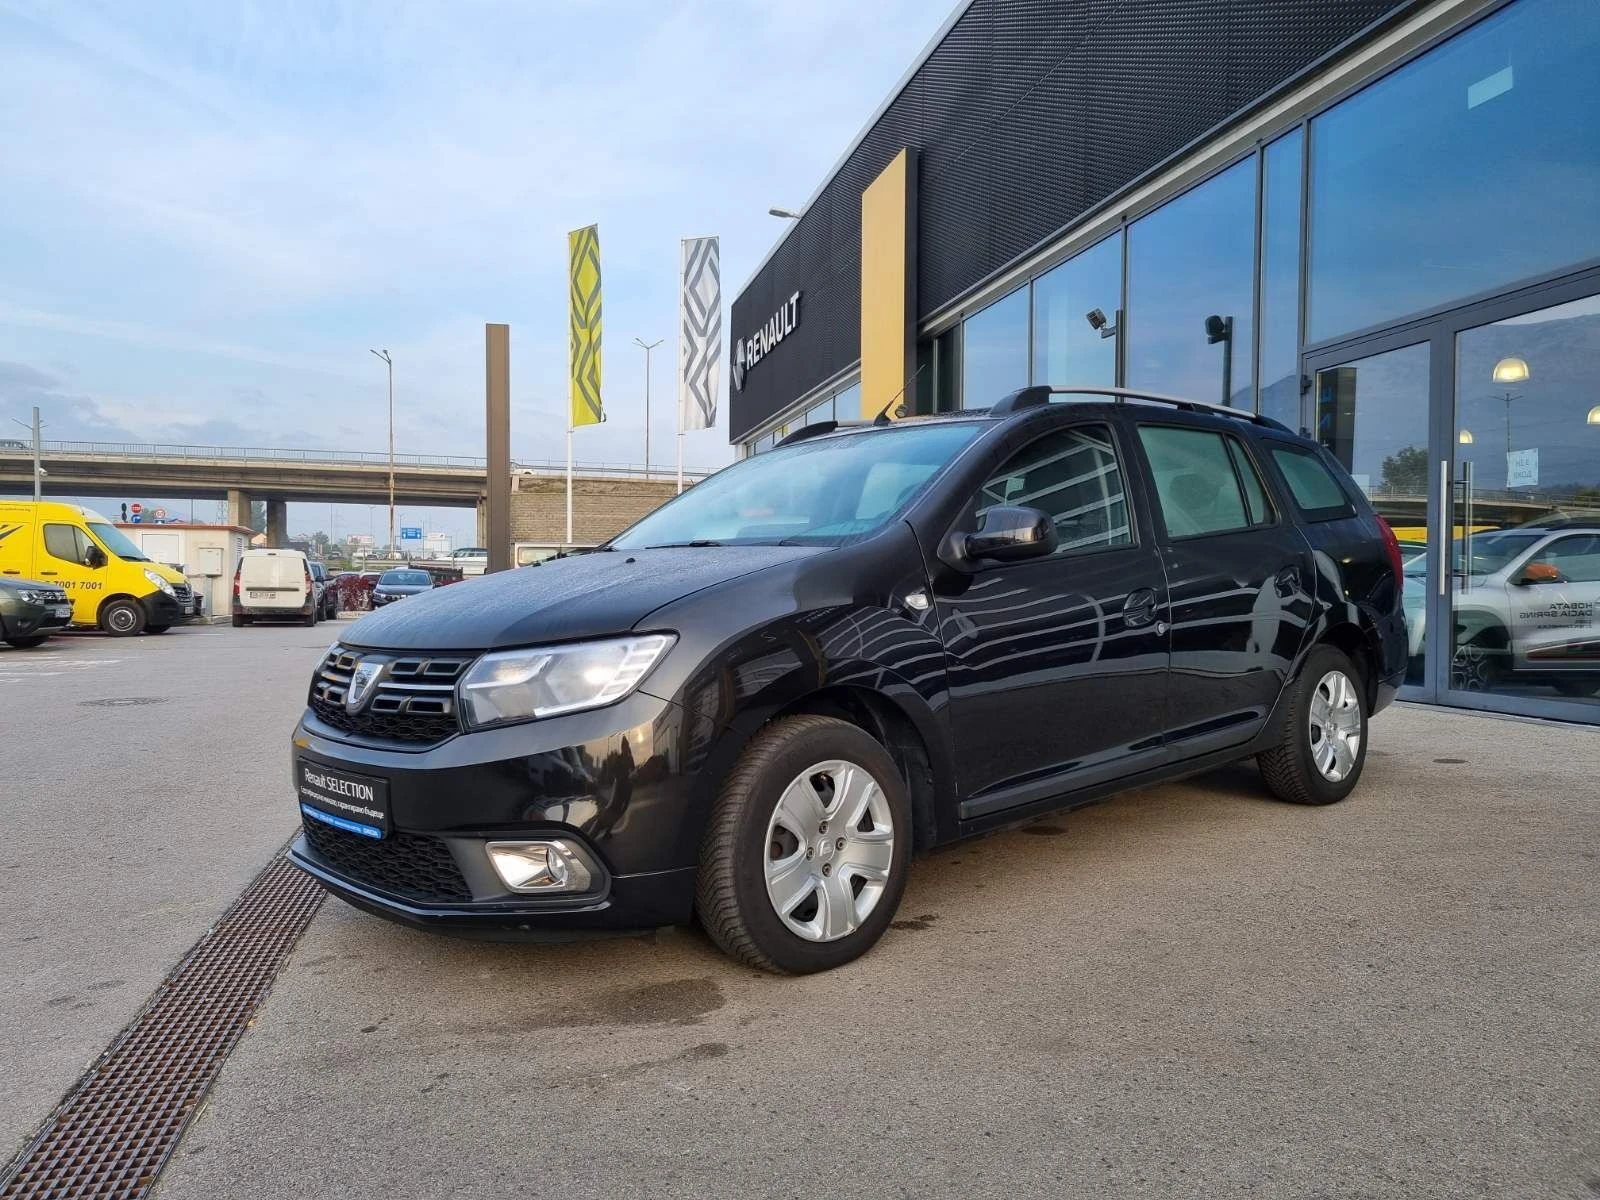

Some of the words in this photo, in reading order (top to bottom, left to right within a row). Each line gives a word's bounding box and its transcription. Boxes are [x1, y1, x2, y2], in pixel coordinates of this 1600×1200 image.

[747, 291, 799, 370] RENAULT
[80, 581, 102, 590] 7001
[304, 768, 326, 789] Renault
[327, 776, 374, 801] SELECTION
